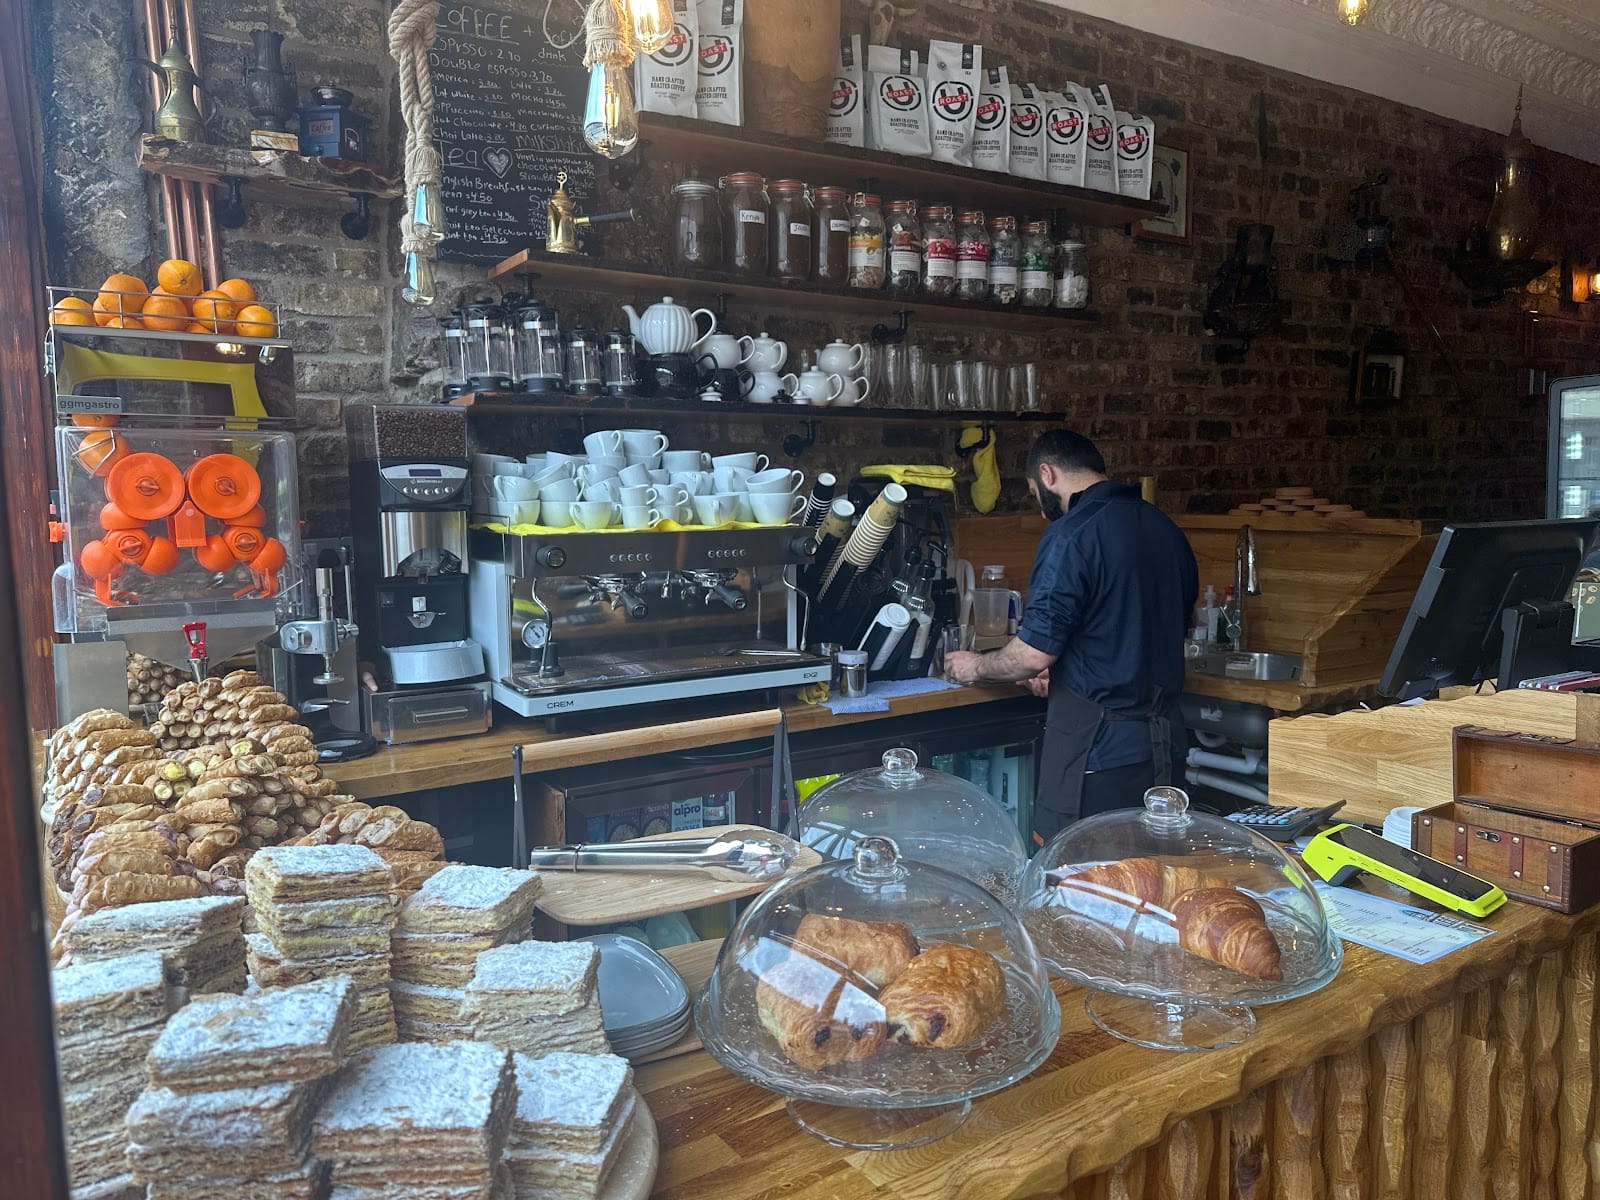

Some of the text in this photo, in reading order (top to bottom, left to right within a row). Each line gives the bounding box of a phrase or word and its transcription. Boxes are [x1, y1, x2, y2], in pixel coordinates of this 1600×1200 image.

[887, 88, 915, 99] ROAST
[938, 94, 968, 107] ROAST
[977, 102, 1000, 115] OAST
[1011, 112, 1038, 124] ROAST
[1051, 117, 1079, 131] ROAST
[1088, 127, 1110, 138] ROAST
[1118, 134, 1144, 148] ROAST
[443, 175, 472, 190] nglish
[60, 400, 120, 410] ggmgastro
[803, 671, 818, 680] EX2
[546, 699, 574, 710] CREM
[674, 803, 701, 818] alpro
